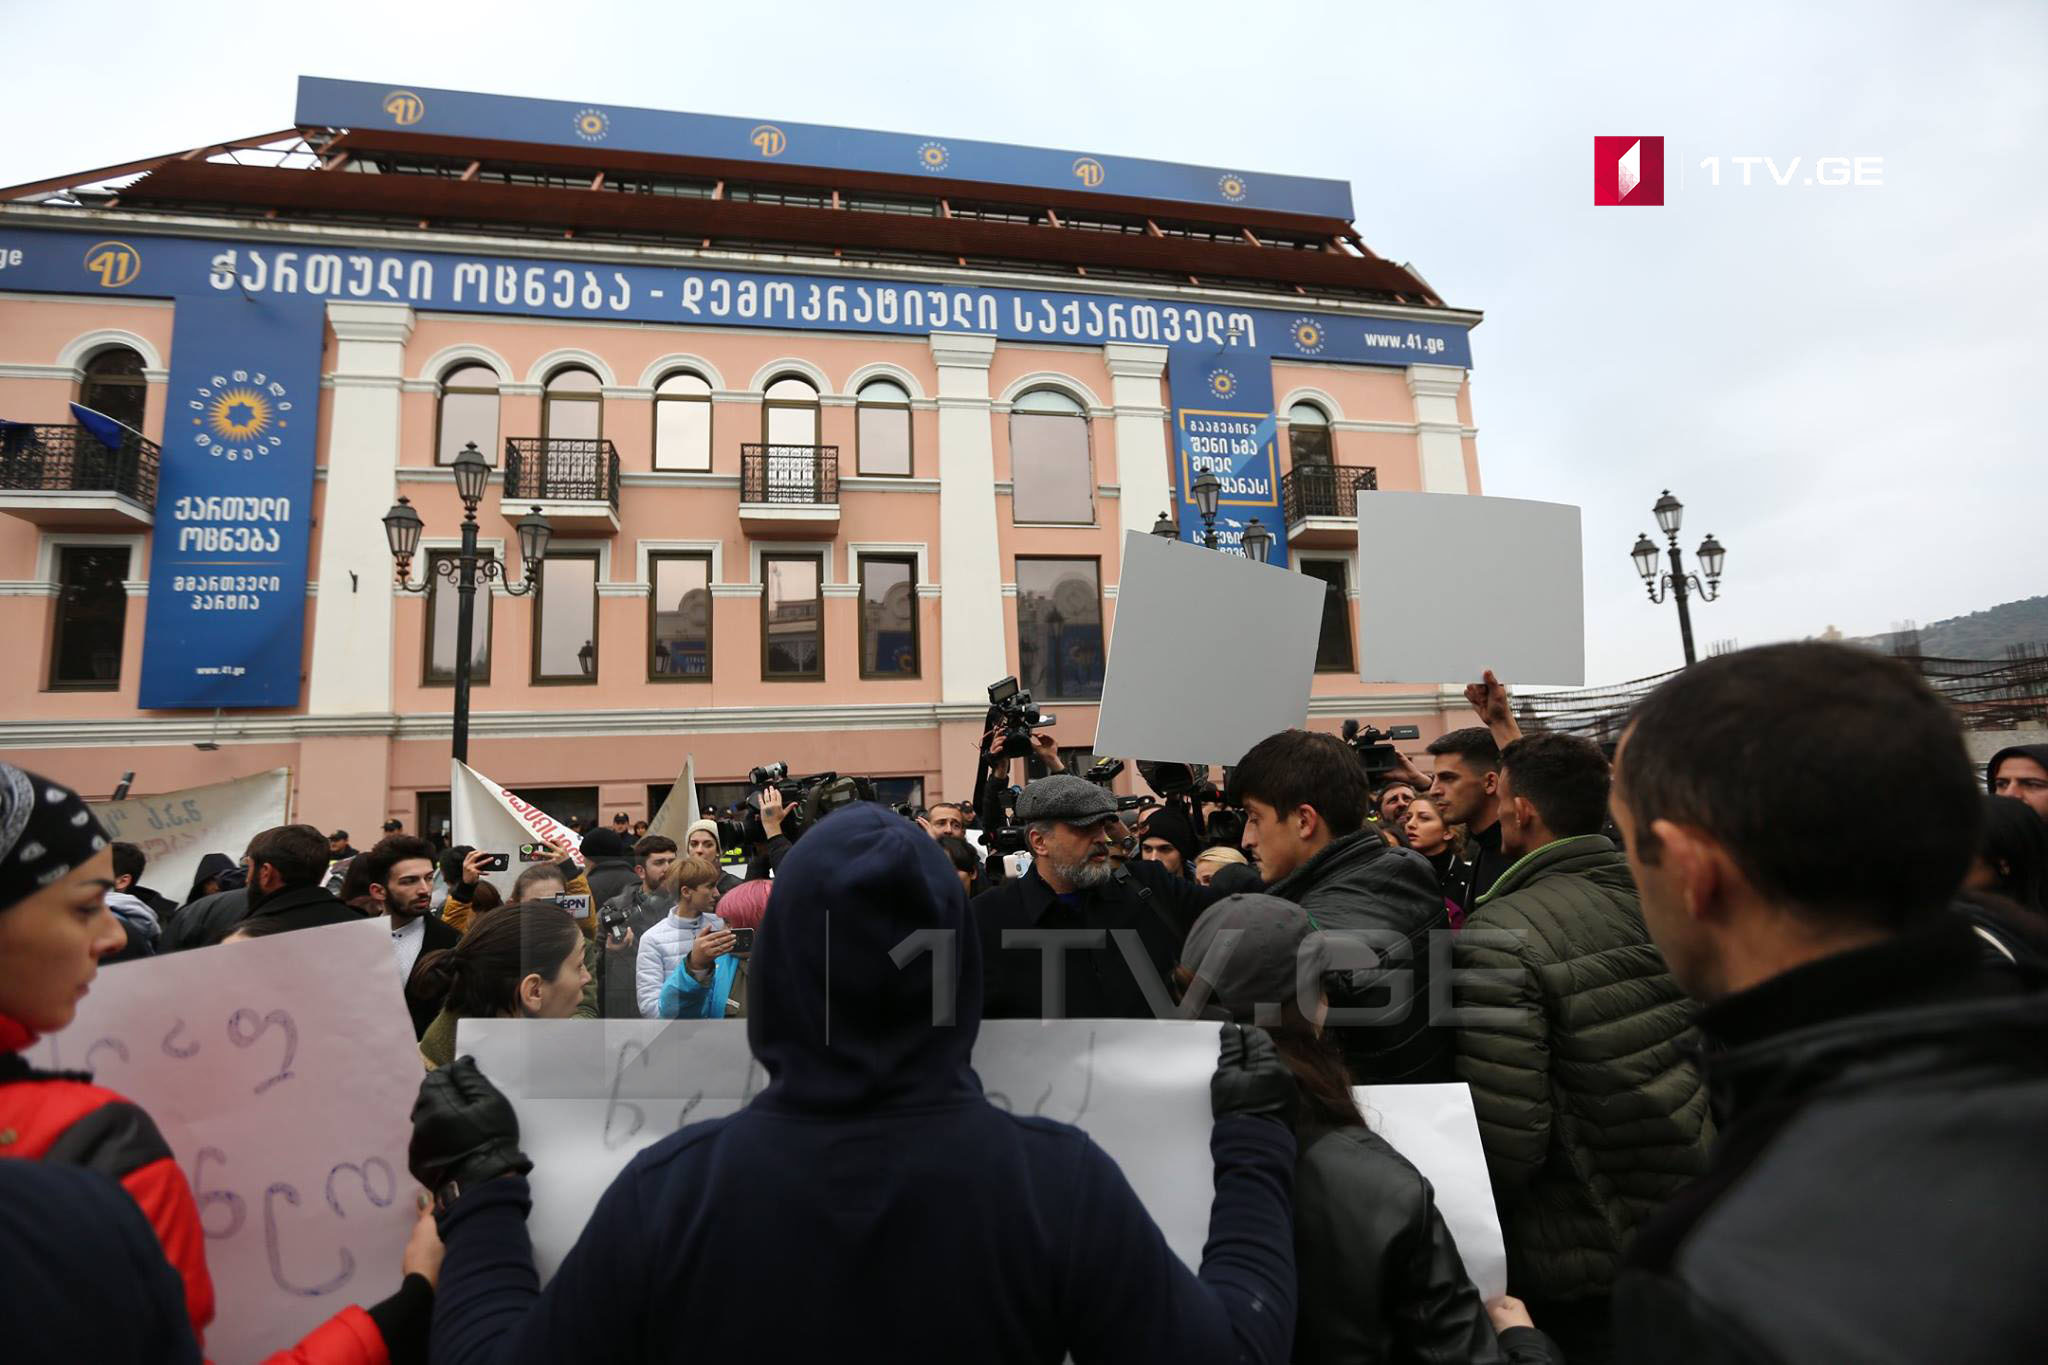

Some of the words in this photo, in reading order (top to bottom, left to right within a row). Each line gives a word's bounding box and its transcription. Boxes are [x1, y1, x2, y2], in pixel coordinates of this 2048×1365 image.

[88, 250, 130, 288] 41
[209, 250, 433, 300] ქართული
[453, 262, 631, 312] ოცნება
[681, 276, 998, 330] დემოკრატიული
[1013, 297, 1256, 347] საქართველო
[1364, 333, 1445, 354] www.41.ge
[1190, 437, 1228, 454] შენი
[1231, 439, 1258, 456] ხმა
[174, 496, 290, 522] ქართული
[179, 527, 280, 552] ოცნება
[173, 576, 280, 592] მმართველი
[191, 595, 260, 611] პარტია
[196, 666, 246, 676] www.41.ge
